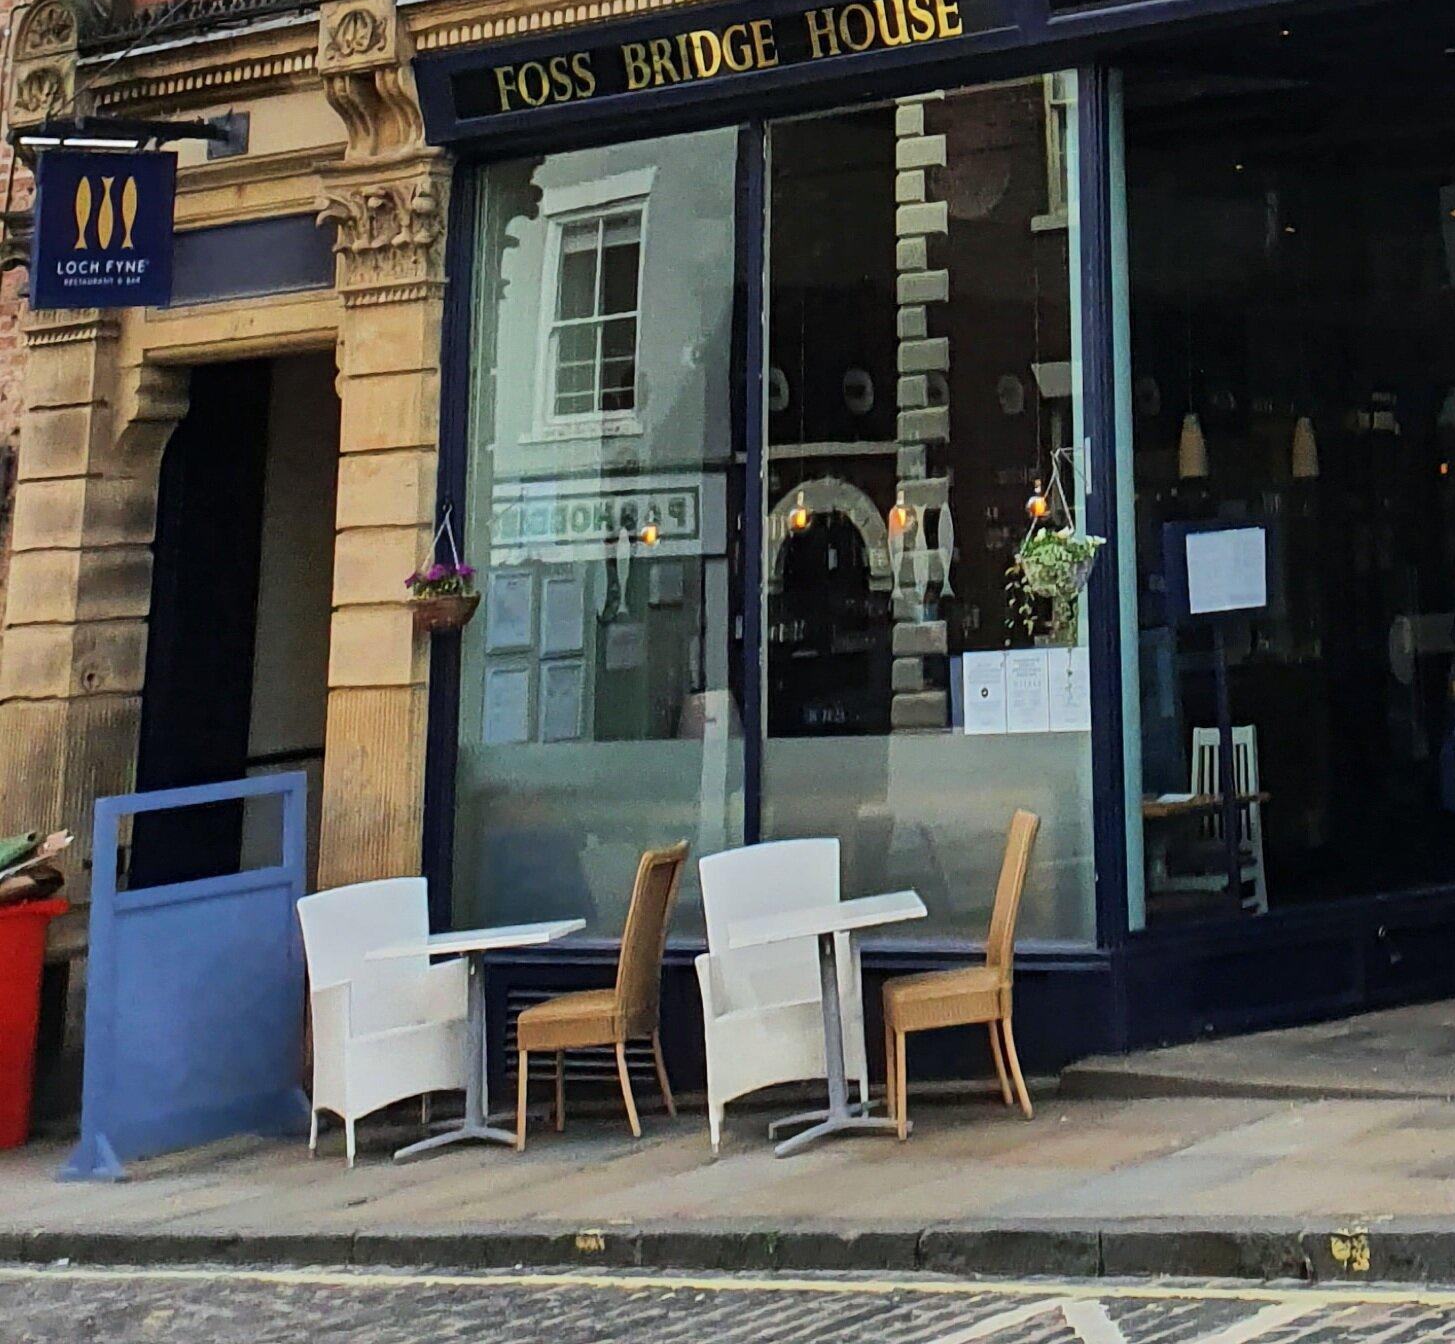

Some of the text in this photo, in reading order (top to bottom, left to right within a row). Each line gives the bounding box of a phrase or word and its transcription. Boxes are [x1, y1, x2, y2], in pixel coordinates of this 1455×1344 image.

[495, 51, 597, 112] FOSS
[622, 18, 779, 93] BRIDGE
[57, 259, 146, 275] LOCH FYNE
